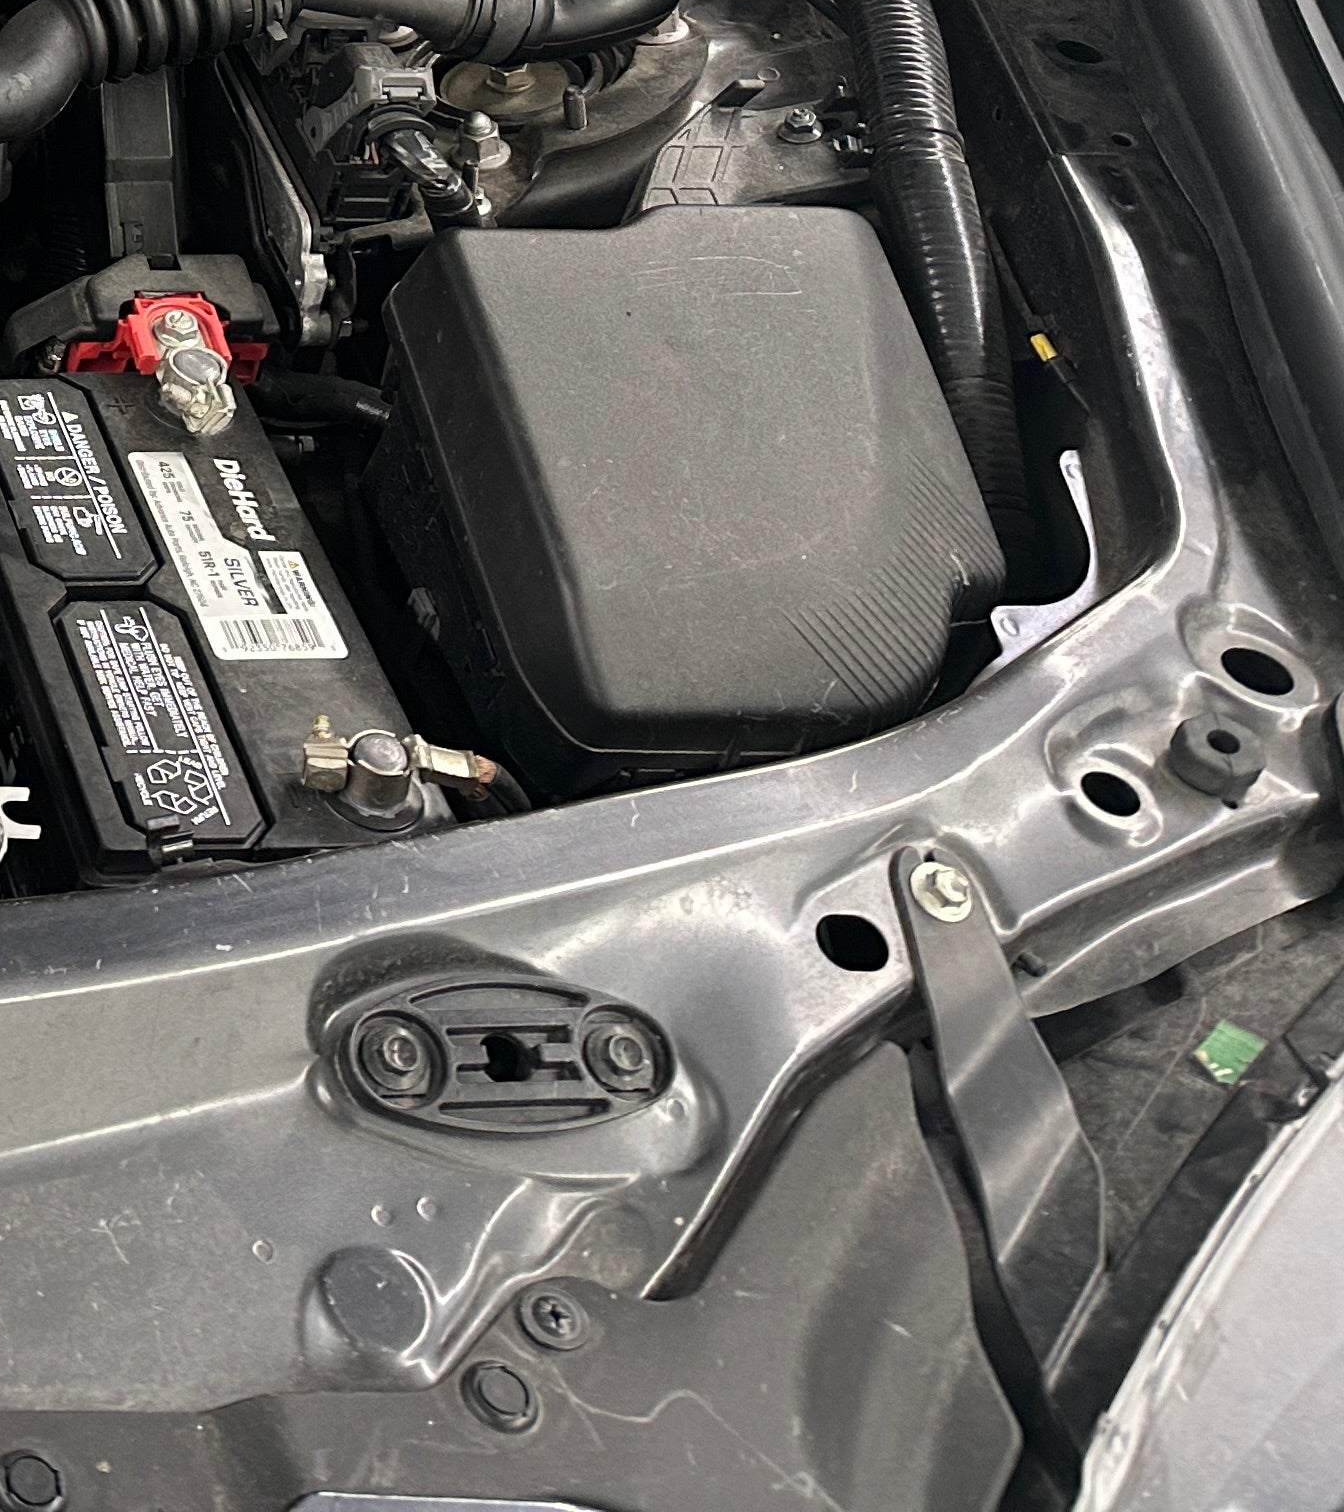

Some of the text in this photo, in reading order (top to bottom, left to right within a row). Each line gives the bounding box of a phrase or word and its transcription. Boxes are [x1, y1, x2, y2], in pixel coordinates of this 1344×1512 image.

[66, 424, 101, 473] DANGER
[92, 486, 127, 533] POISON
[158, 461, 176, 480] 425
[179, 510, 195, 522] 75
[213, 457, 276, 542] DieHard
[224, 557, 259, 607] SILVER
[130, 675, 148, 694] HELP
[139, 696, 157, 715] FAST
[148, 691, 164, 707] GET
[150, 667, 167, 686] EYES
